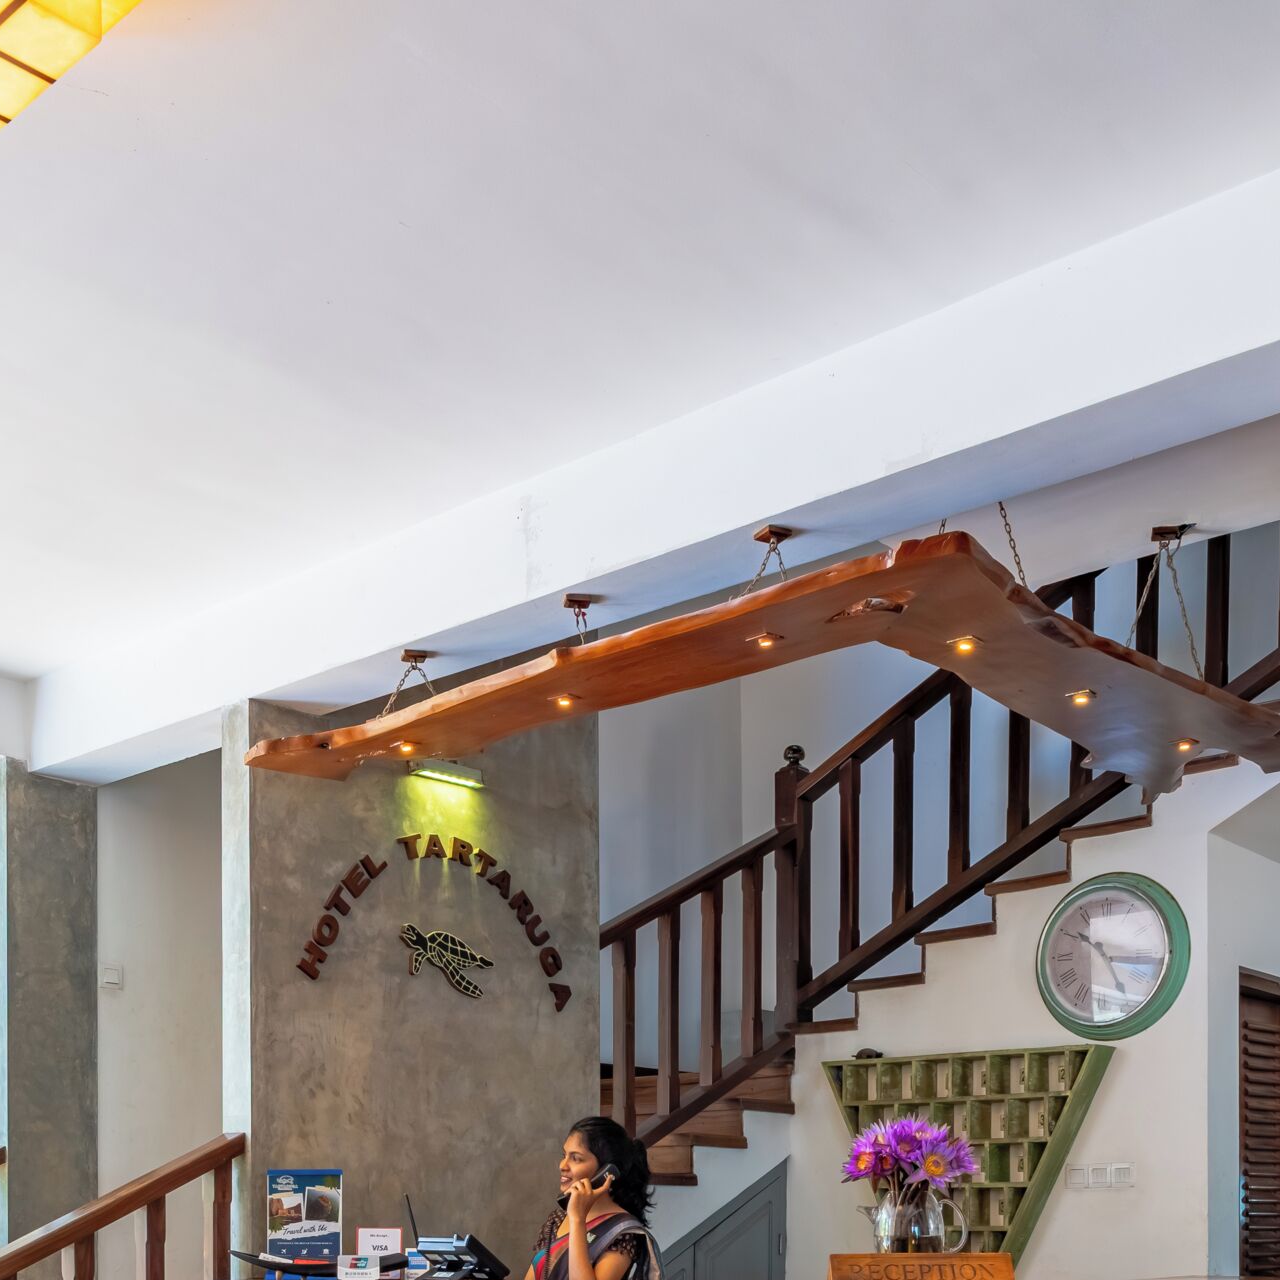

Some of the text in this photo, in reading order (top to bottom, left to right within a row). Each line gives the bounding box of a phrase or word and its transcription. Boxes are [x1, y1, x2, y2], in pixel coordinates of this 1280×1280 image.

[296, 833, 573, 1013] HOTEL TARTARUGA
[282, 1226, 303, 1236] Travel
